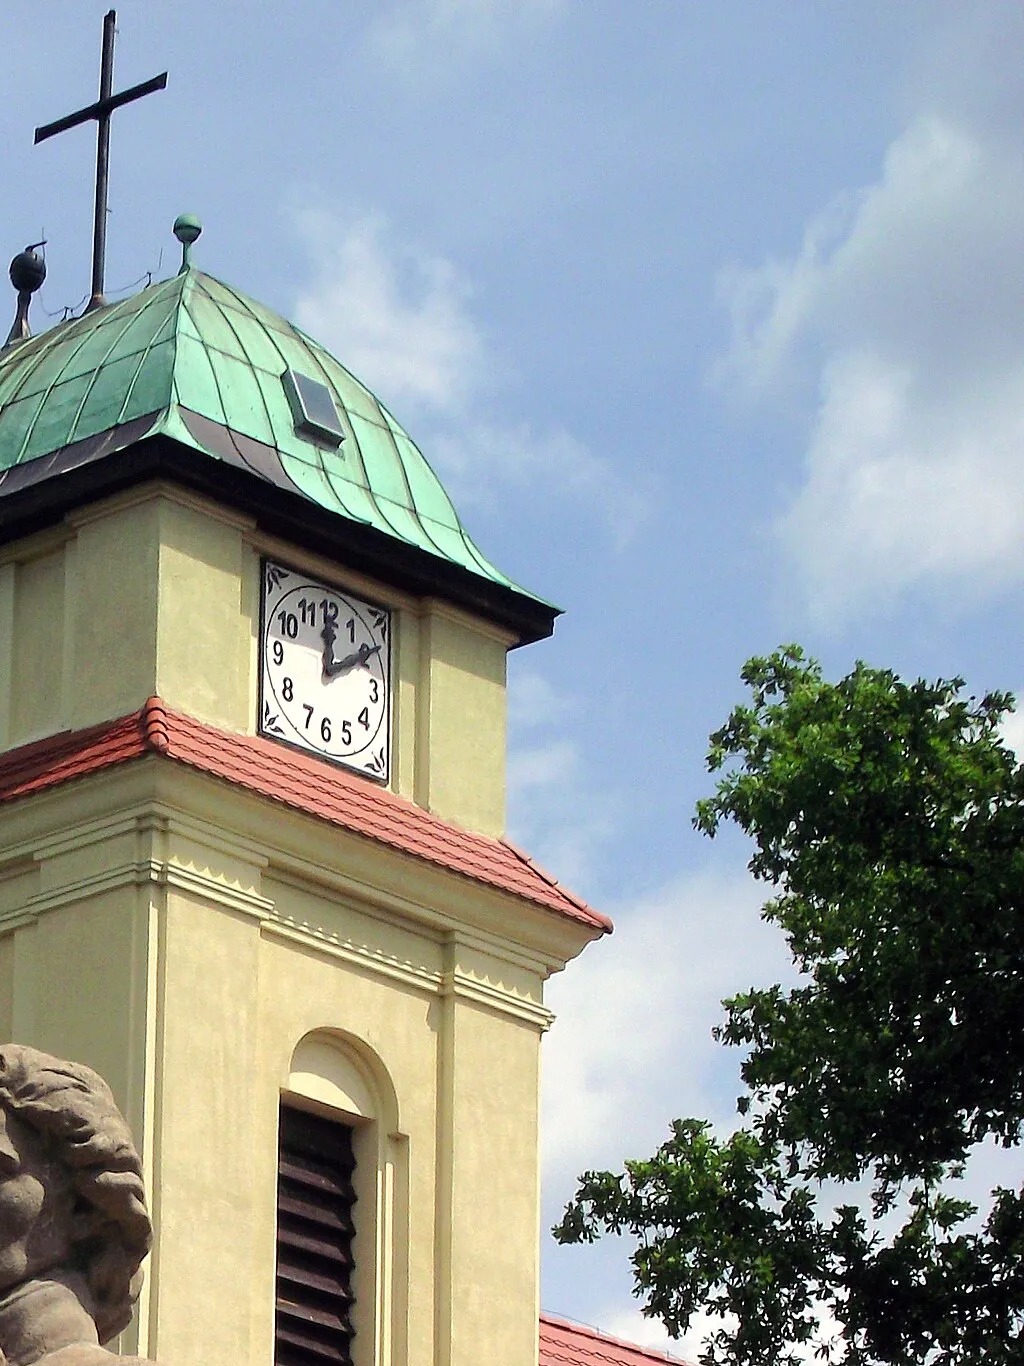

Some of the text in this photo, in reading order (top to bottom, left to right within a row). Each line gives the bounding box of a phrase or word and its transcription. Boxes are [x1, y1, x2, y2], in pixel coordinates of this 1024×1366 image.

[278, 610, 299, 639] 10
[298, 597, 316, 627] 11
[320, 599, 339, 629] 12
[346, 617, 355, 643] 1
[273, 641, 284, 666] 9
[282, 677, 294, 702] 8
[369, 679, 379, 703] 3
[302, 704, 314, 729] 7
[358, 707, 370, 731] 4
[320, 717, 332, 742] 6
[341, 720, 352, 745] 5
